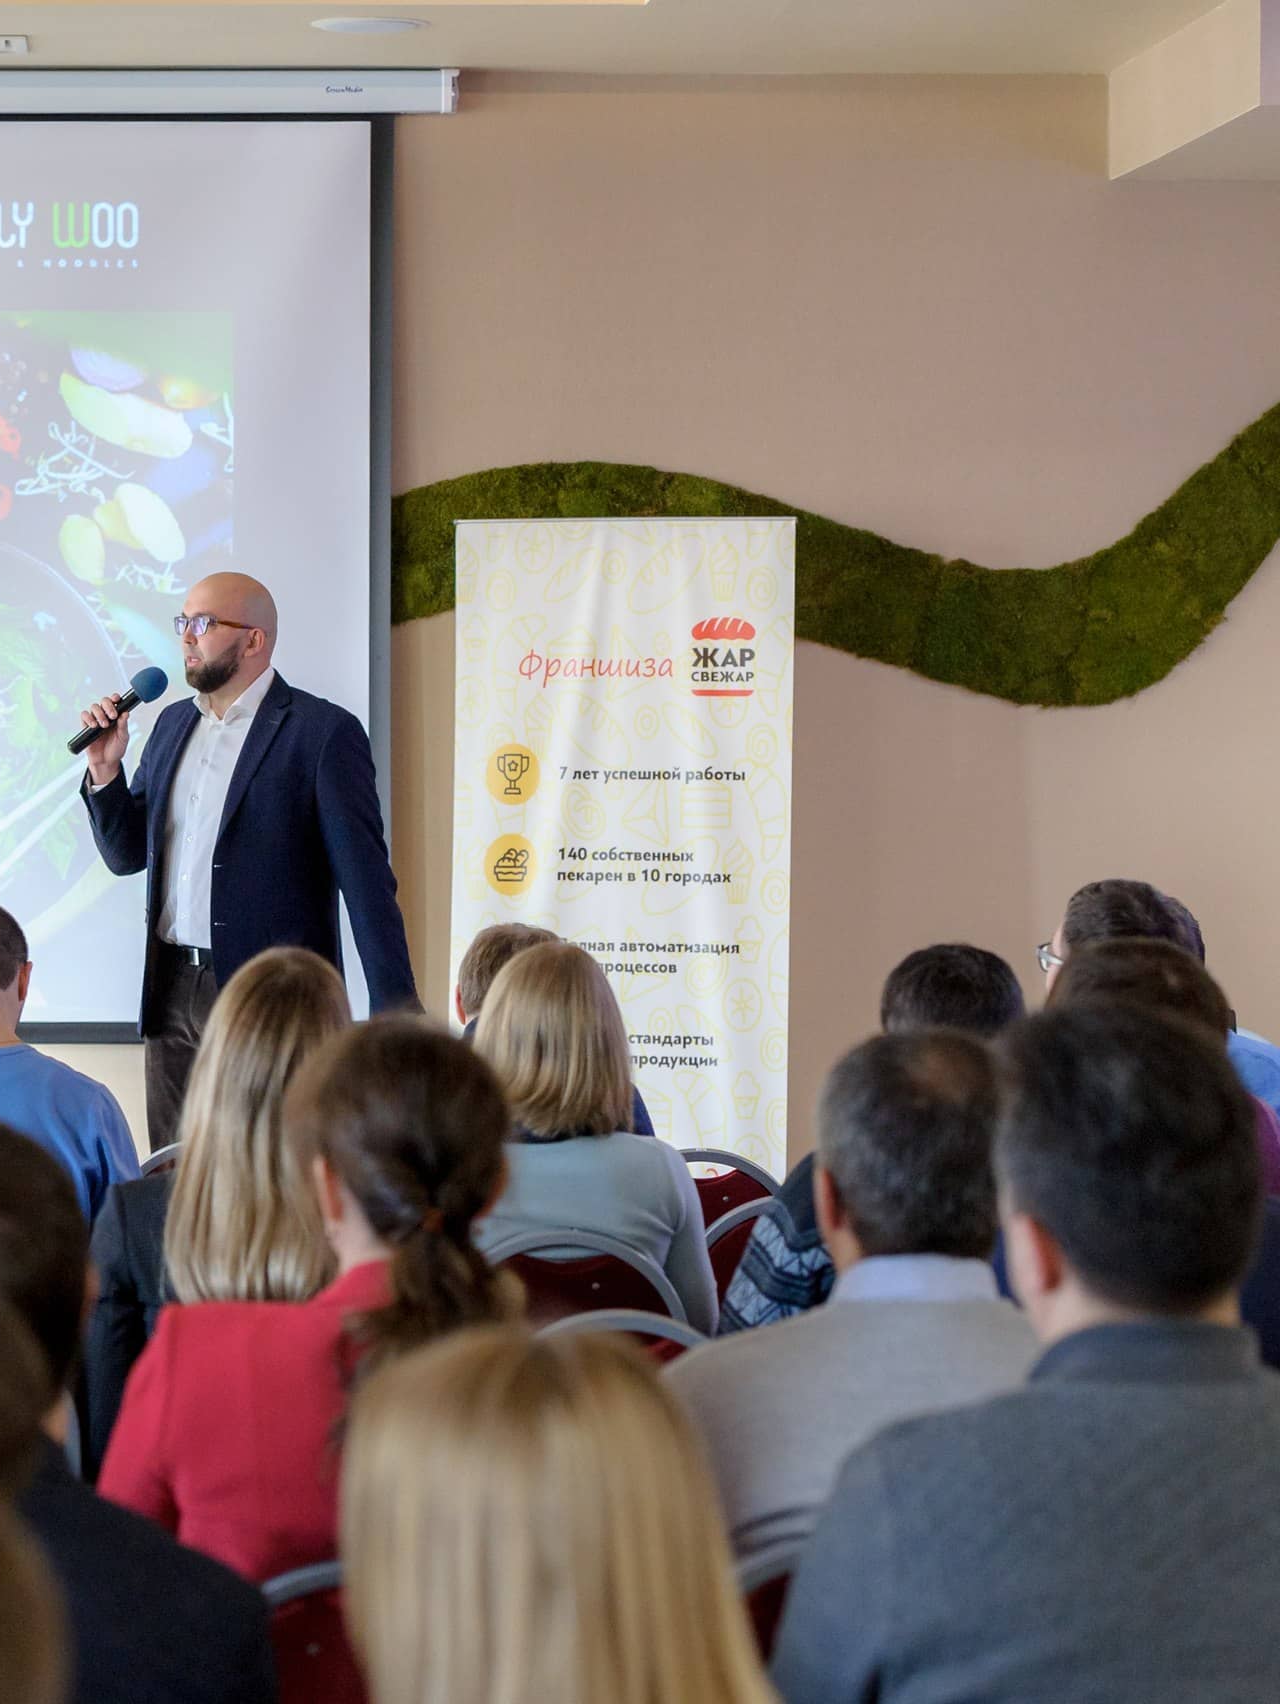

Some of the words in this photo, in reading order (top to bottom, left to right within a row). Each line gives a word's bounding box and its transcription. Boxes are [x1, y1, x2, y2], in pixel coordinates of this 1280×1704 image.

[52, 202, 139, 249] WOO
[692, 648, 755, 668] ЖАР
[518, 649, 673, 688] Франшиза
[691, 671, 755, 683] СВЕЖАР
[559, 766, 568, 780] 7
[572, 769, 600, 781] лет
[604, 767, 682, 784] успешной
[685, 766, 746, 784] работы
[558, 847, 587, 861] 140
[591, 847, 694, 862] собственных
[557, 871, 623, 885] пекарен
[628, 872, 636, 882] в
[641, 869, 660, 883] 10
[665, 872, 732, 887] городах
[619, 942, 740, 956] автоматизация
[628, 1034, 714, 1049] стандарты
[630, 1055, 719, 1069] продукции
